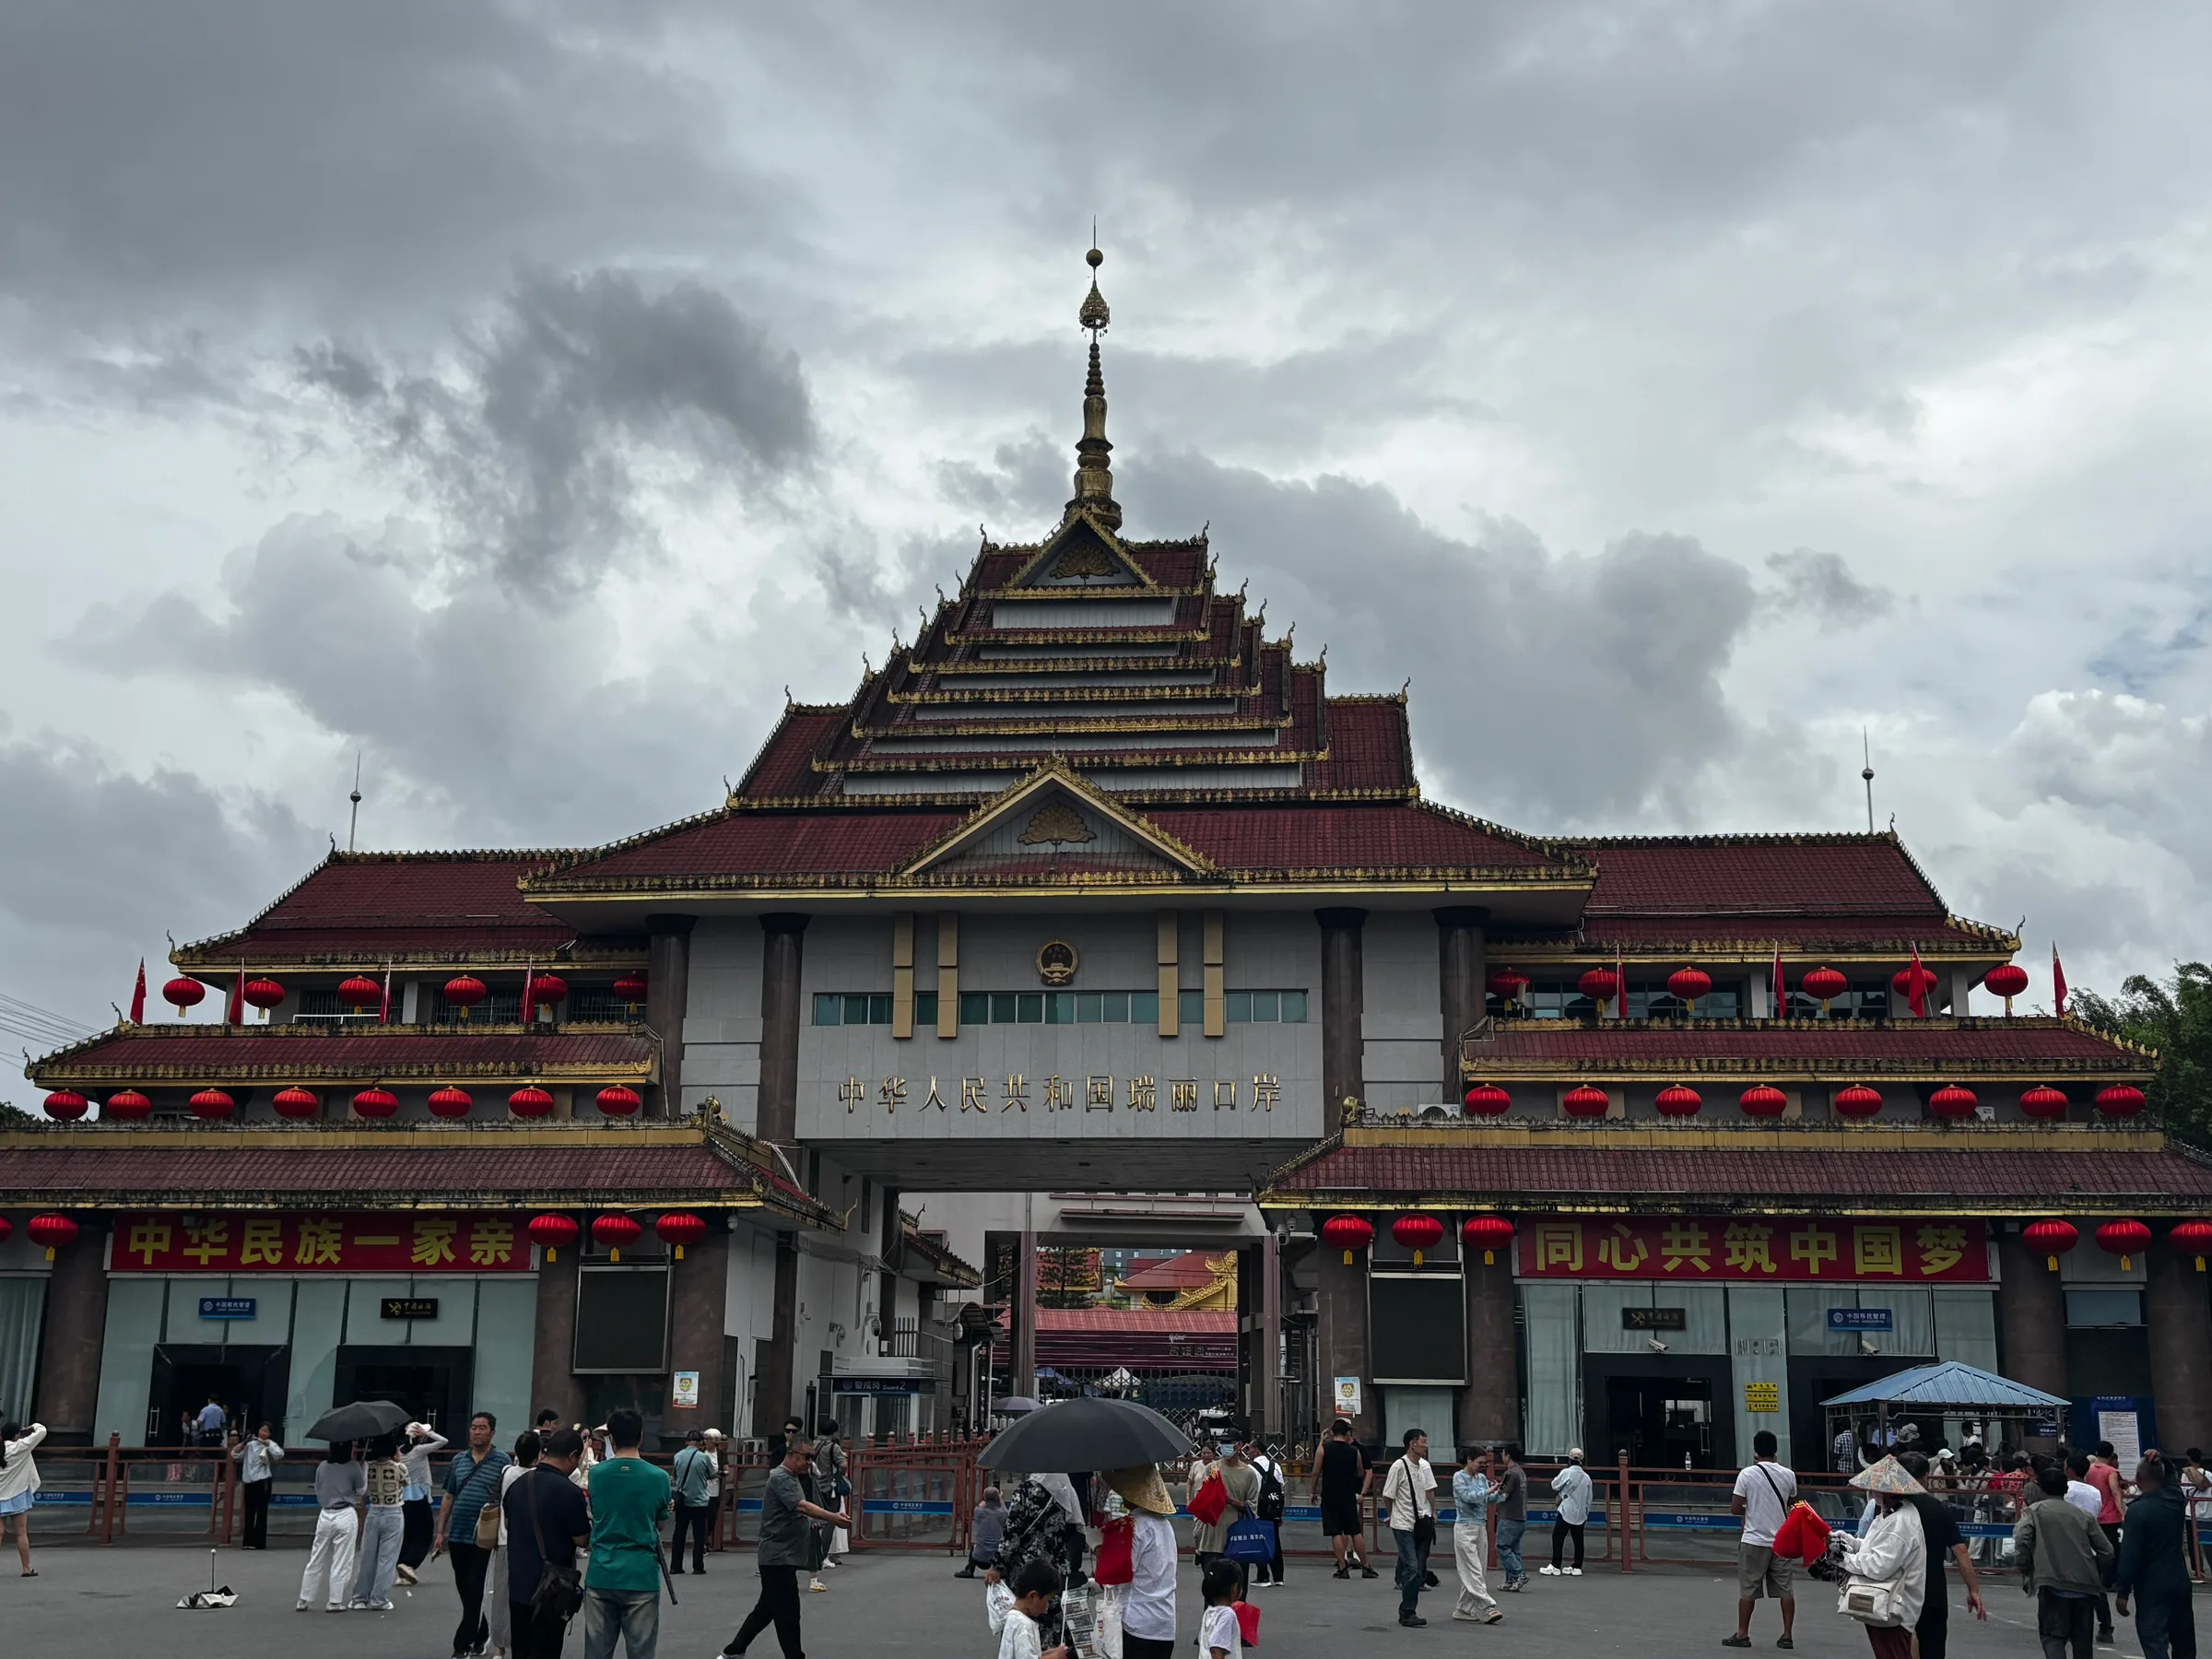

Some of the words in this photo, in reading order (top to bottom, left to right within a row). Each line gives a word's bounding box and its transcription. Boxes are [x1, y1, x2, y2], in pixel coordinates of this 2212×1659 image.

[838, 1073, 1282, 1114] 中华人民共和国瑞丽口岸
[127, 1217, 514, 1266] 中华民族一家亲
[1535, 1222, 1969, 1276] 同心共筑中国梦
[900, 1382, 906, 1390] 2
